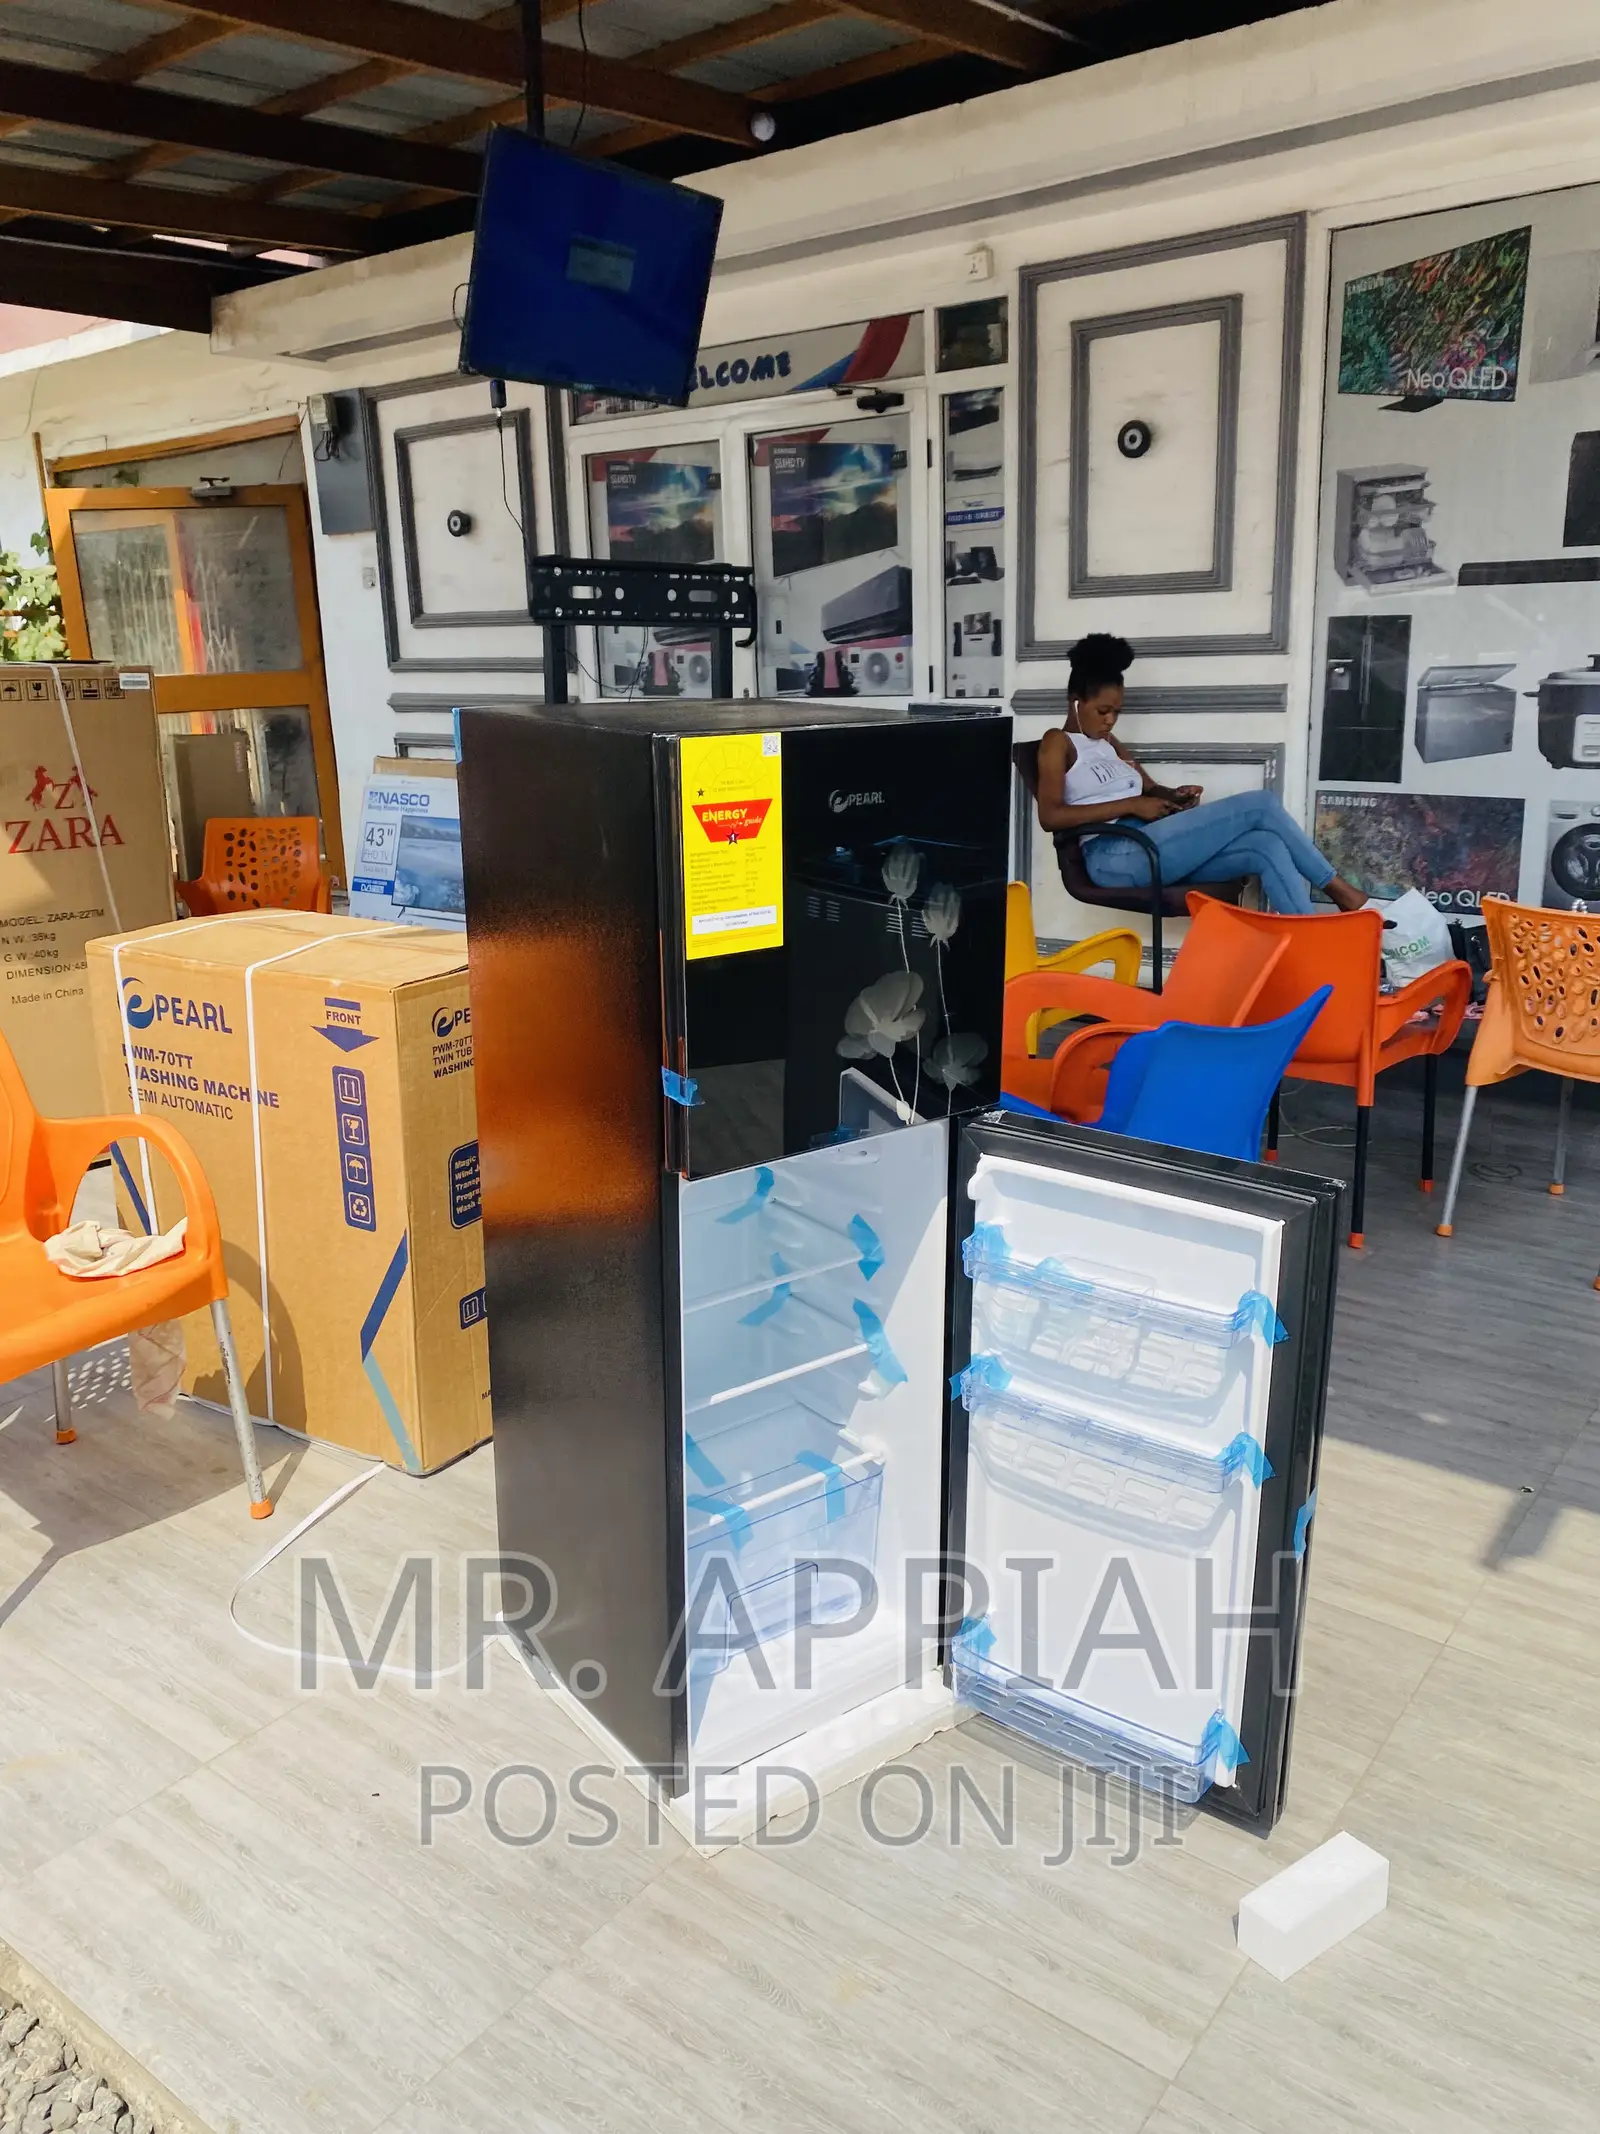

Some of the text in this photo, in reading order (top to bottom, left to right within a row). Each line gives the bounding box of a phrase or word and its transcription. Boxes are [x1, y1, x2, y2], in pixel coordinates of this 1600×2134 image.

[1407, 366, 1508, 390] Neo QLED
[378, 791, 430, 807] NASCO
[848, 791, 885, 806] PEARL
[1320, 795, 1378, 808] SAMSUNG
[702, 808, 748, 825] ENERGY
[4, 814, 126, 855] ZARA
[12, 988, 85, 1005] Made in China
[154, 993, 233, 1035] PEARL
[326, 1010, 362, 1026] FRONT
[433, 1046, 473, 1067] TWIN TUB
[202, 1079, 281, 1110] MACHNE
[160, 1092, 235, 1121] AUTOMATIC
[454, 1155, 477, 1170] Magic
[456, 1200, 476, 1216] Wash
